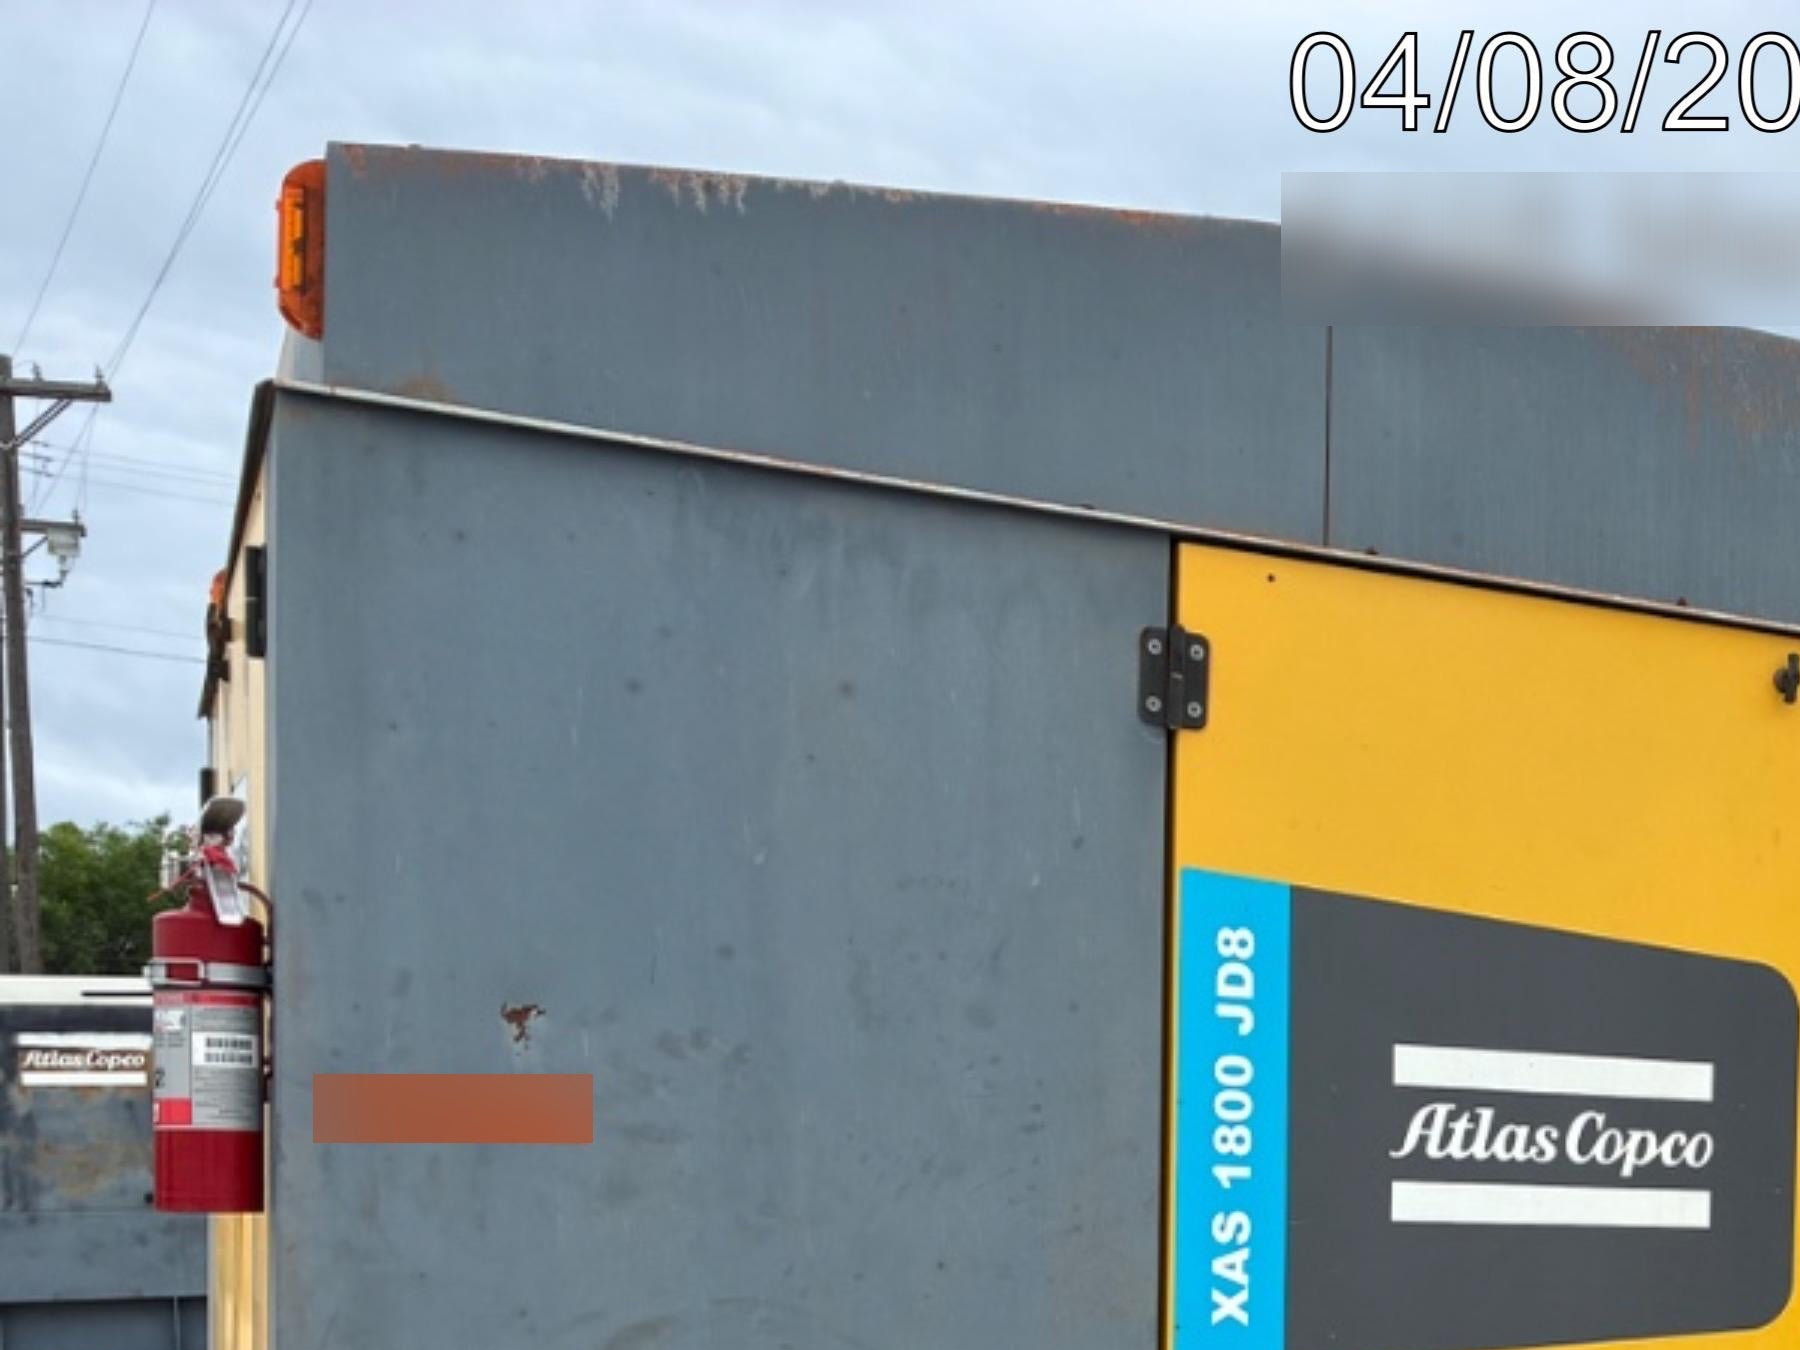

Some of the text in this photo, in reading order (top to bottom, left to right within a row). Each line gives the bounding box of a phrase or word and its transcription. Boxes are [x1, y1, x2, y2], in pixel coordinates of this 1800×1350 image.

[1211, 927, 1256, 1326] XAS 1800 JD8
[1390, 1103, 1714, 1178] Atlas Copco
